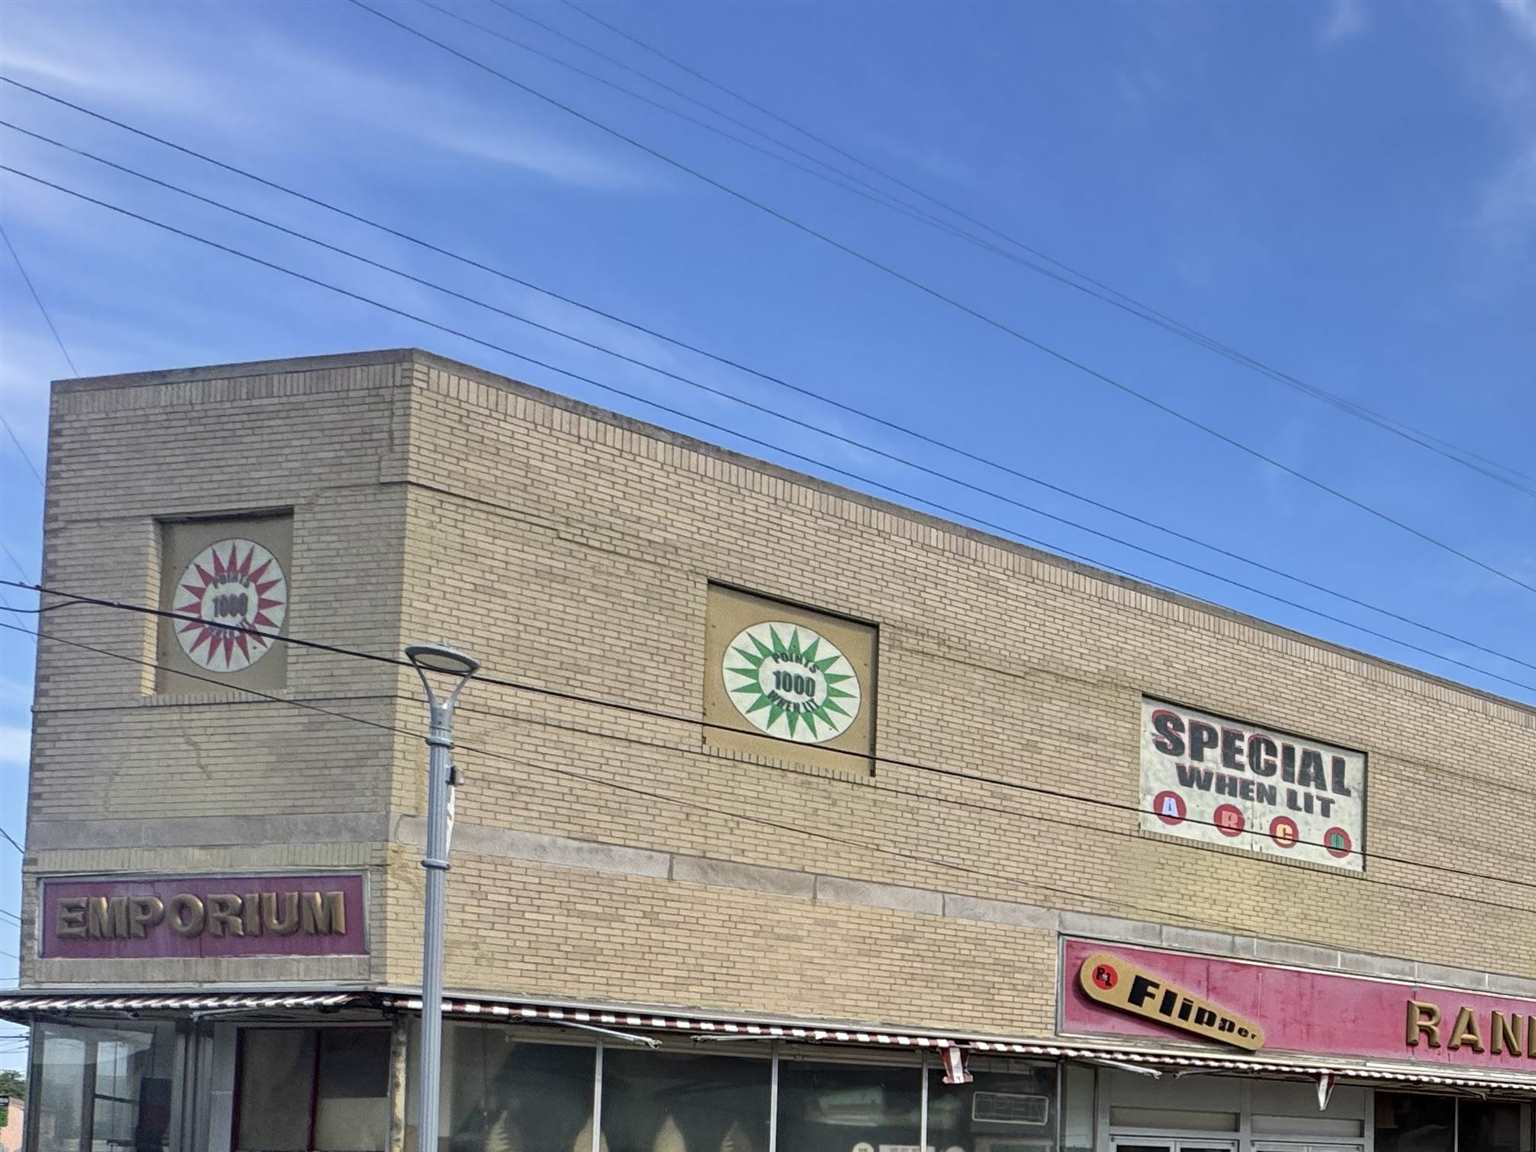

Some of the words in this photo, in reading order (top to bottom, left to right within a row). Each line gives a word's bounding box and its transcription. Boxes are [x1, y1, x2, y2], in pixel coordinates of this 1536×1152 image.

[212, 592, 248, 618] 1000
[771, 651, 820, 674] POINTS
[767, 690, 801, 713] WHEN
[773, 670, 816, 698] 1000
[1151, 709, 1352, 798] SPECIAL
[1175, 762, 1277, 807] WHEN
[1286, 788, 1336, 819] LIT
[55, 890, 347, 941] EMPORIUM
[1128, 974, 1258, 1040] Flipper
